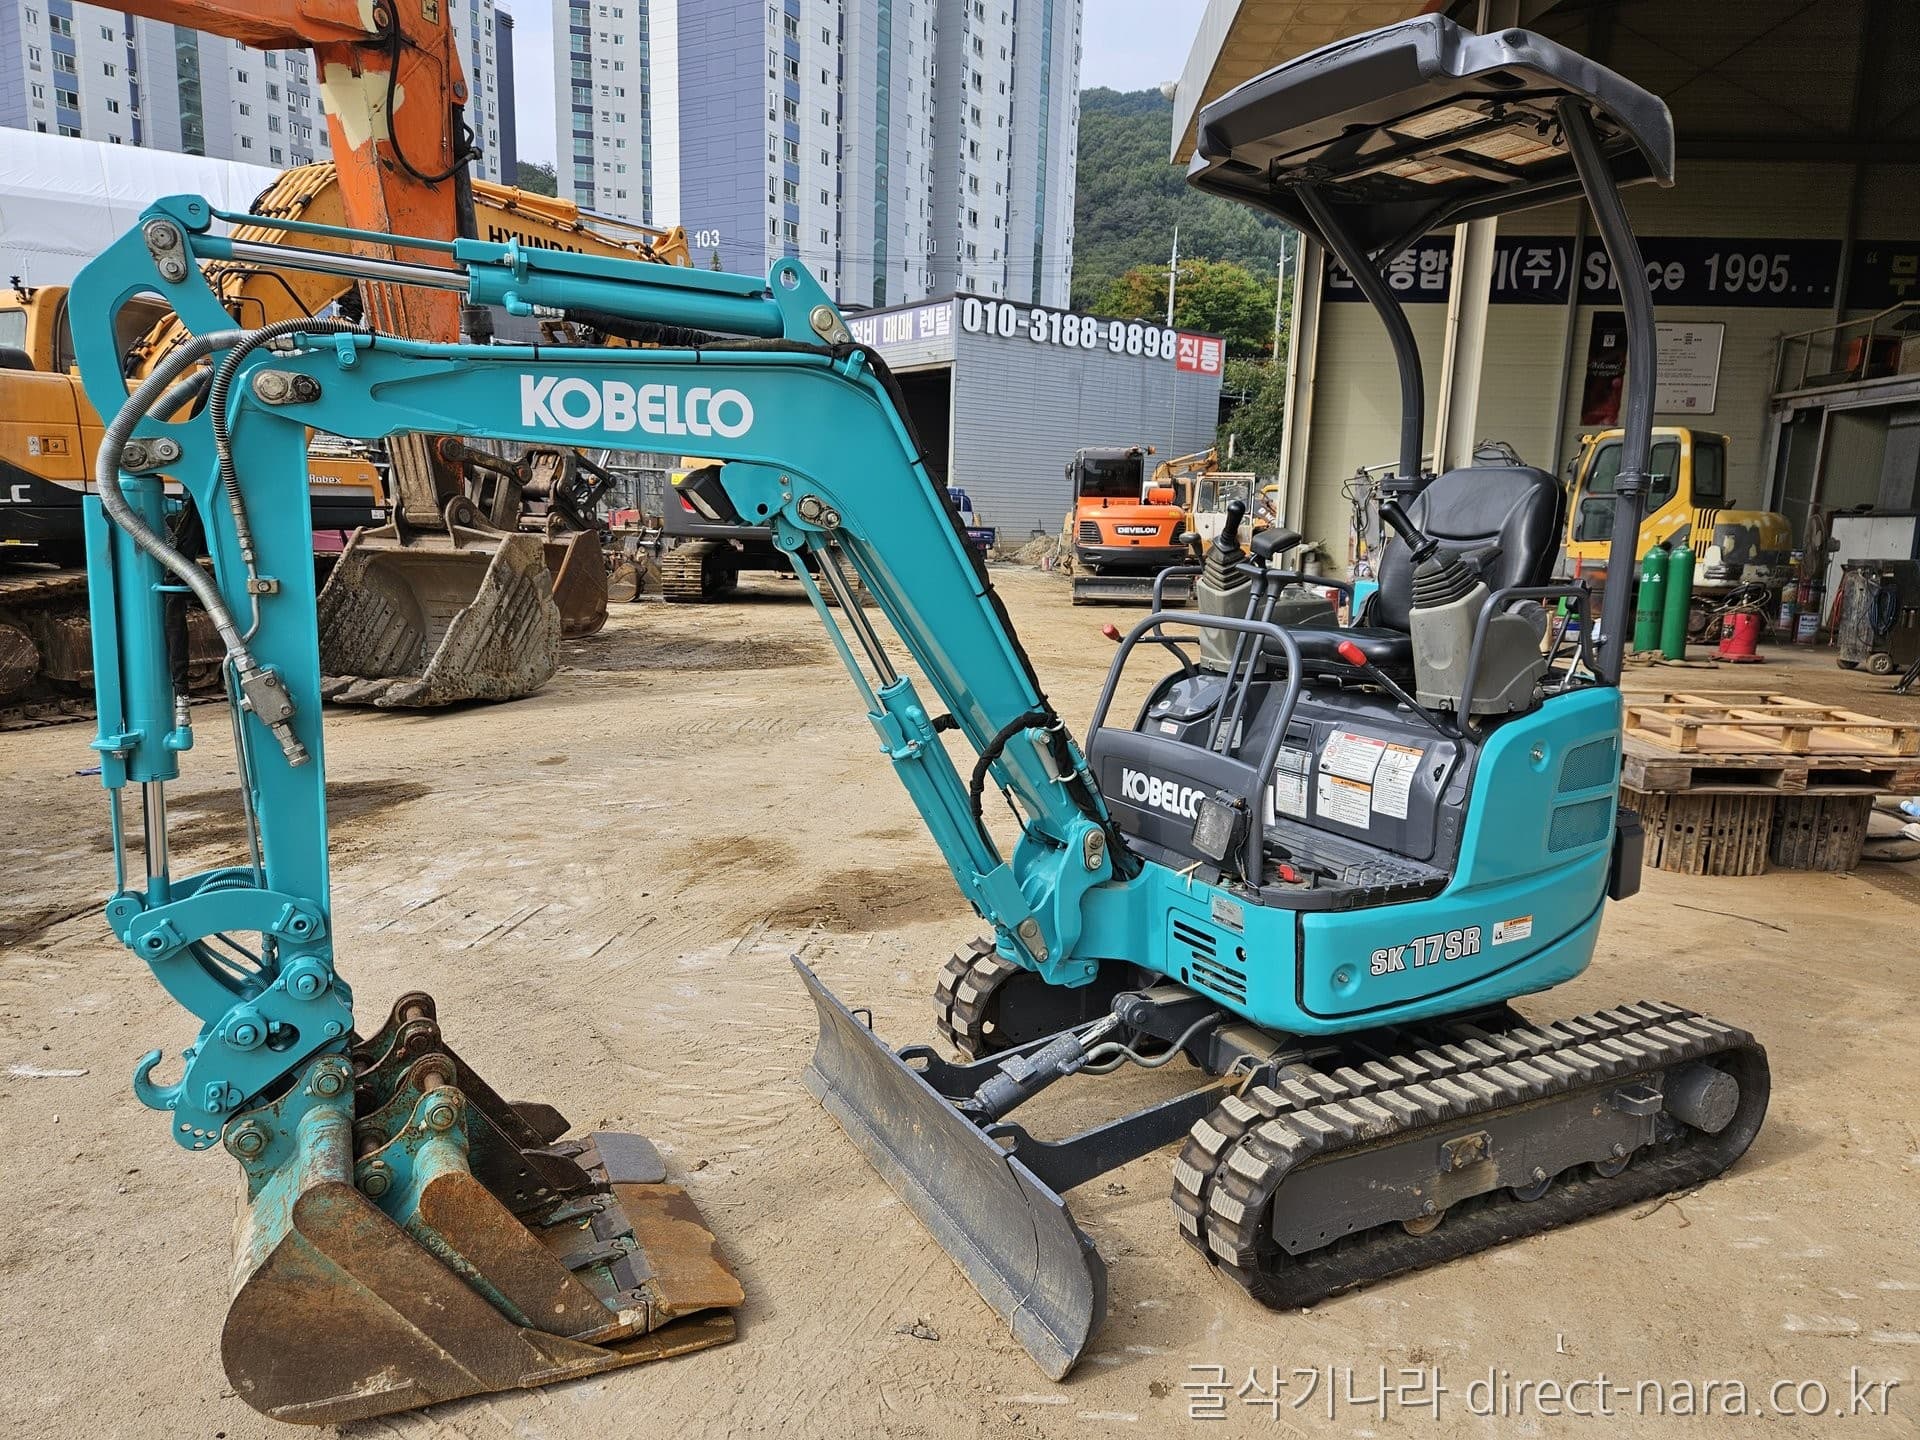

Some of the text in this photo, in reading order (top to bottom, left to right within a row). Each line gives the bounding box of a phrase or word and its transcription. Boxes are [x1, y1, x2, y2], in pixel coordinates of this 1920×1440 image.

[695, 230, 720, 248] 103
[1584, 251, 1685, 291] Sice
[882, 311, 914, 343] 매매
[919, 304, 952, 338] 렌탈
[962, 298, 1176, 361] 010-3188-9898
[1178, 336, 1221, 372] 직통
[520, 374, 754, 438] KOBELCO
[1117, 526, 1157, 535] DEVELON
[1370, 945, 1407, 976] SK
[1408, 925, 1482, 968] 17SR
